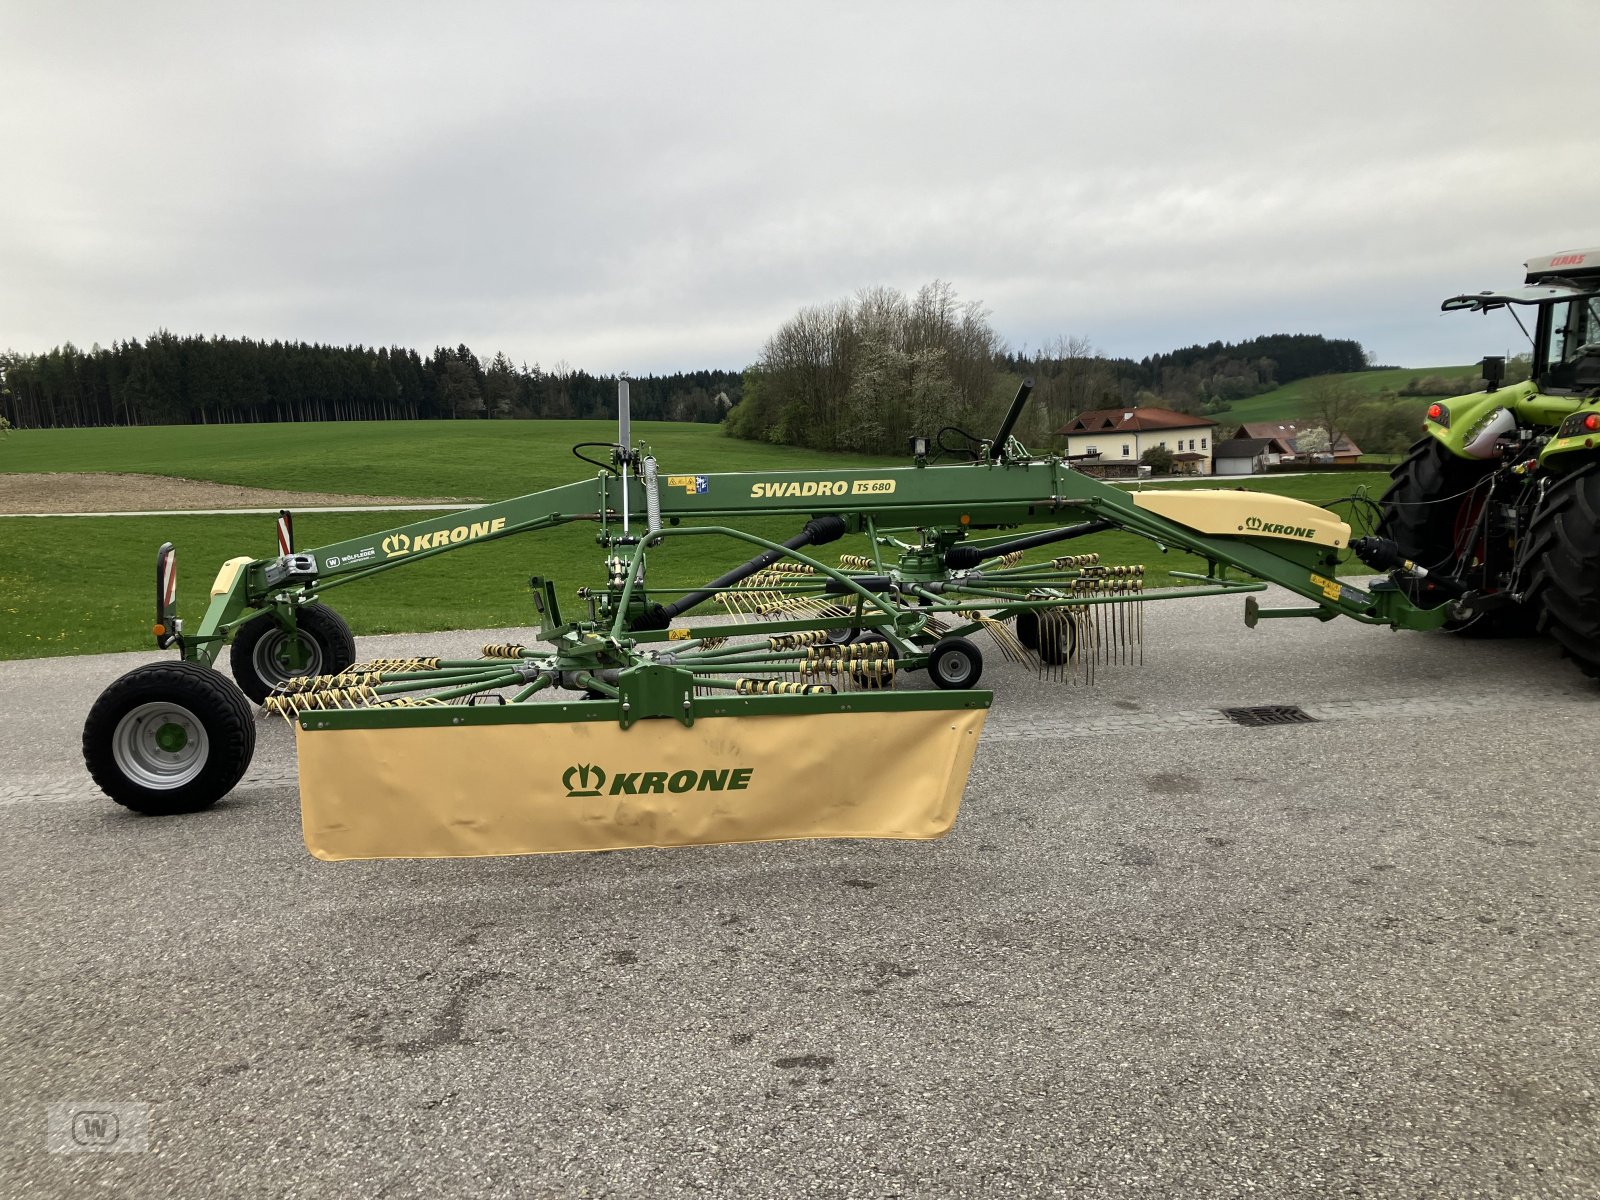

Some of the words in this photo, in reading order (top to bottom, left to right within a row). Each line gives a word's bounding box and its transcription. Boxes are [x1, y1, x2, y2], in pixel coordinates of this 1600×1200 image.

[750, 480, 849, 498] SWADRO
[857, 483, 869, 492] TS
[871, 482, 891, 491] 680
[412, 517, 506, 553] KRONE
[1262, 522, 1316, 538] KRONE
[608, 767, 755, 796] KRONE
